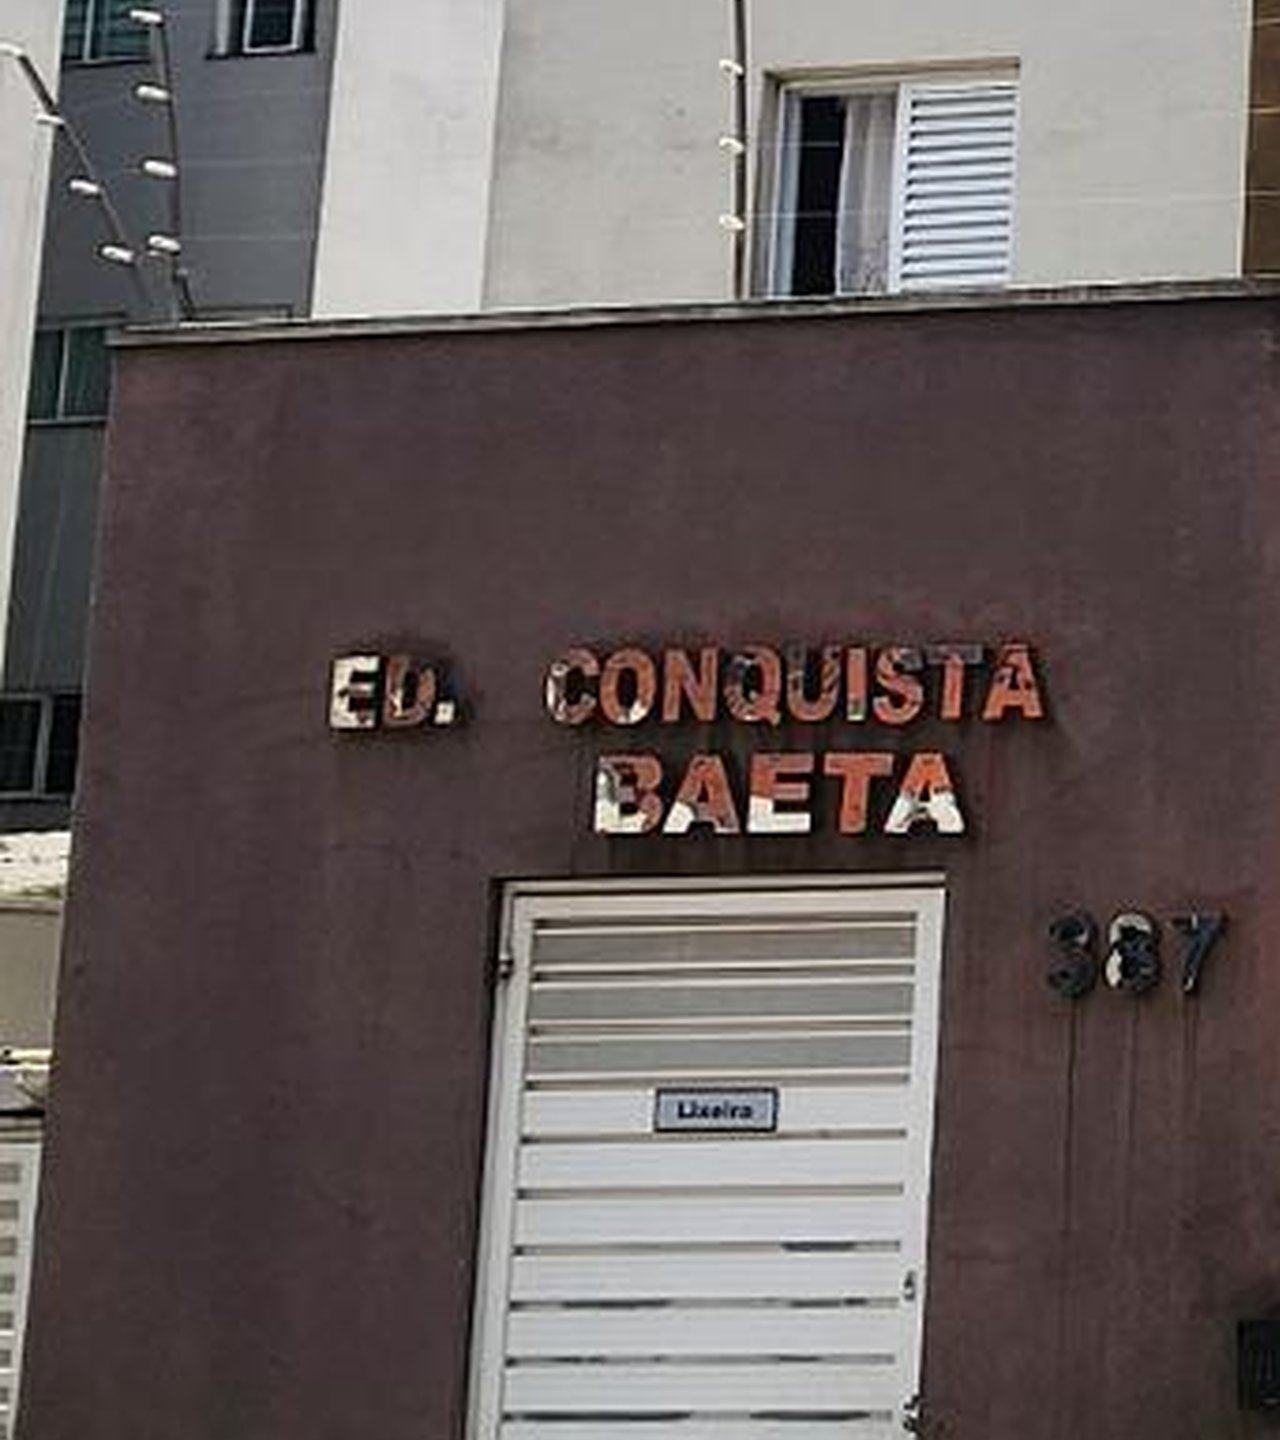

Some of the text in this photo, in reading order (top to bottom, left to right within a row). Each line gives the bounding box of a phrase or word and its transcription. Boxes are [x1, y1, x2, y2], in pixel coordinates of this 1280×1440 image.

[330, 643, 1046, 728] ED. CONQUISTA
[594, 752, 966, 834] BAETA
